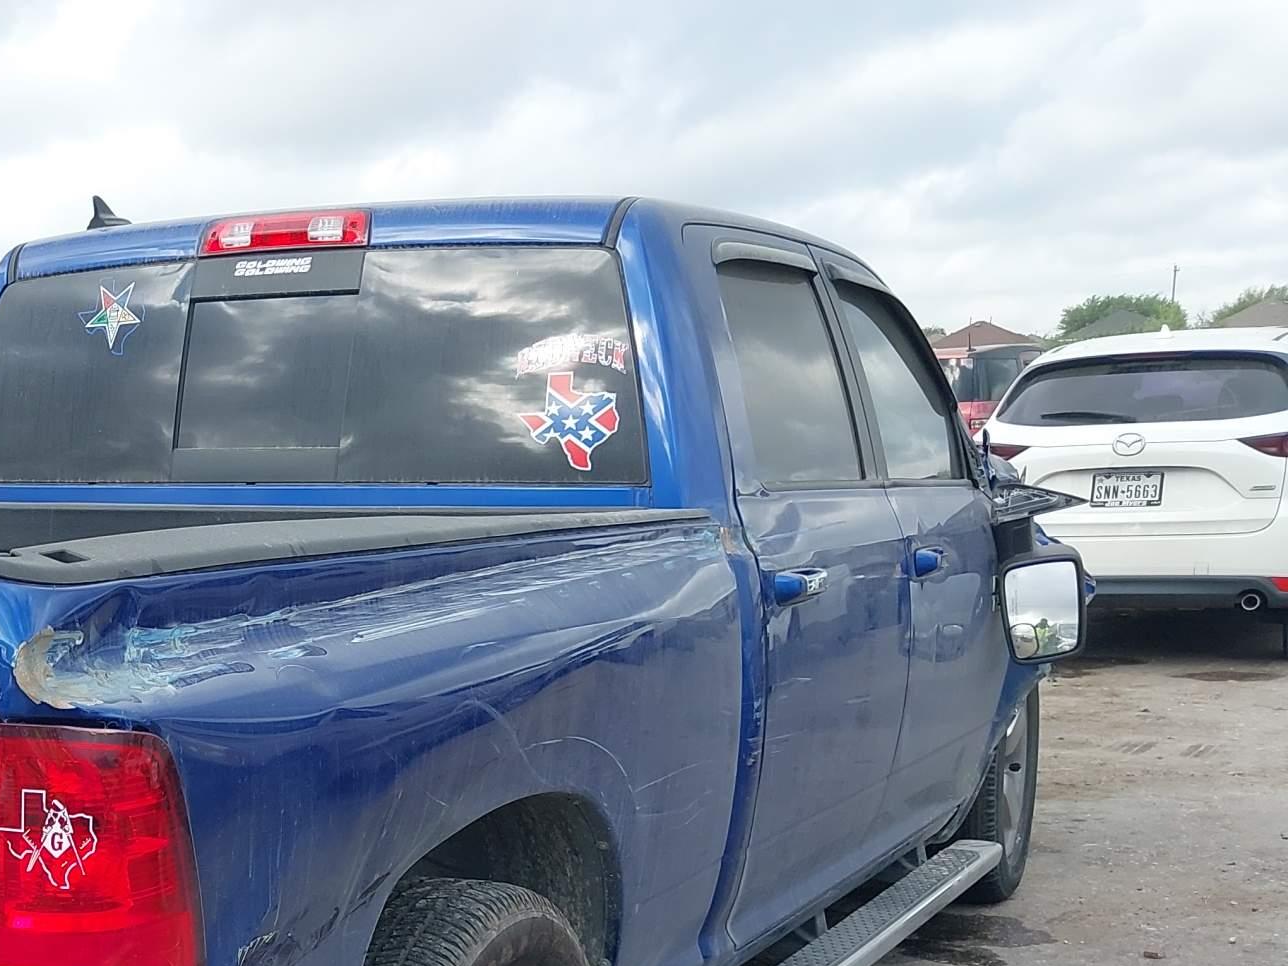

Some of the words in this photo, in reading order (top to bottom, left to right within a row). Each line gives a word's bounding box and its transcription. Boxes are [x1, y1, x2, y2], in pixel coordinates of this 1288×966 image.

[235, 257, 313, 269] GOLDWING
[234, 265, 312, 276] GOLDWING
[50, 832, 63, 851] G
